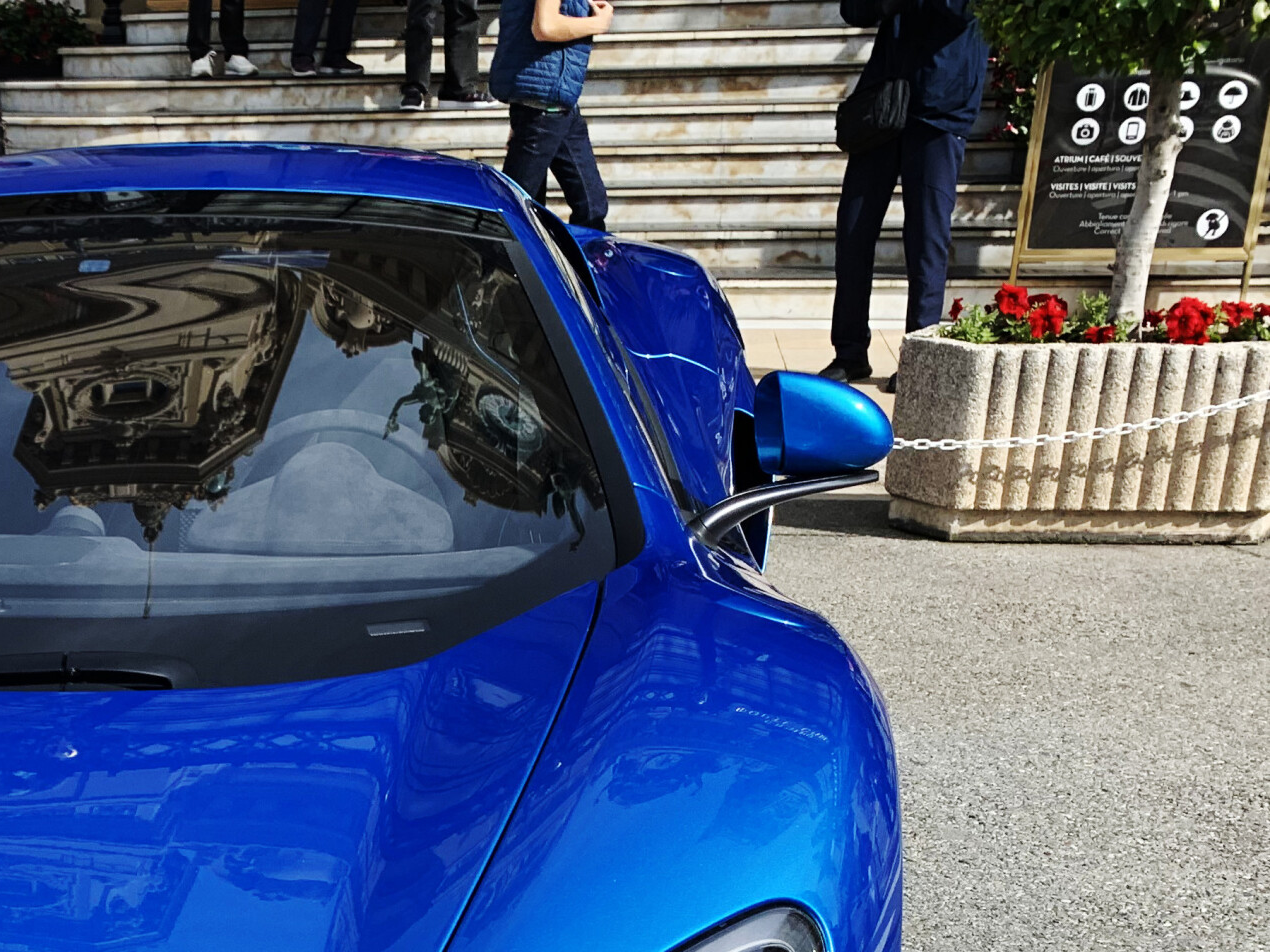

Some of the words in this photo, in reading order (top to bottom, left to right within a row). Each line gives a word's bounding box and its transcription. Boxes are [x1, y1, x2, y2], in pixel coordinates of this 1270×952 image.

[1054, 155, 1084, 164] ATRIUM
[1089, 152, 1110, 164] CAFÉ
[1050, 182, 1079, 191] VISITES
[1084, 182, 1108, 191] VISITE
[1113, 182, 1136, 191] VISITS
[1094, 227, 1121, 235] Correct
